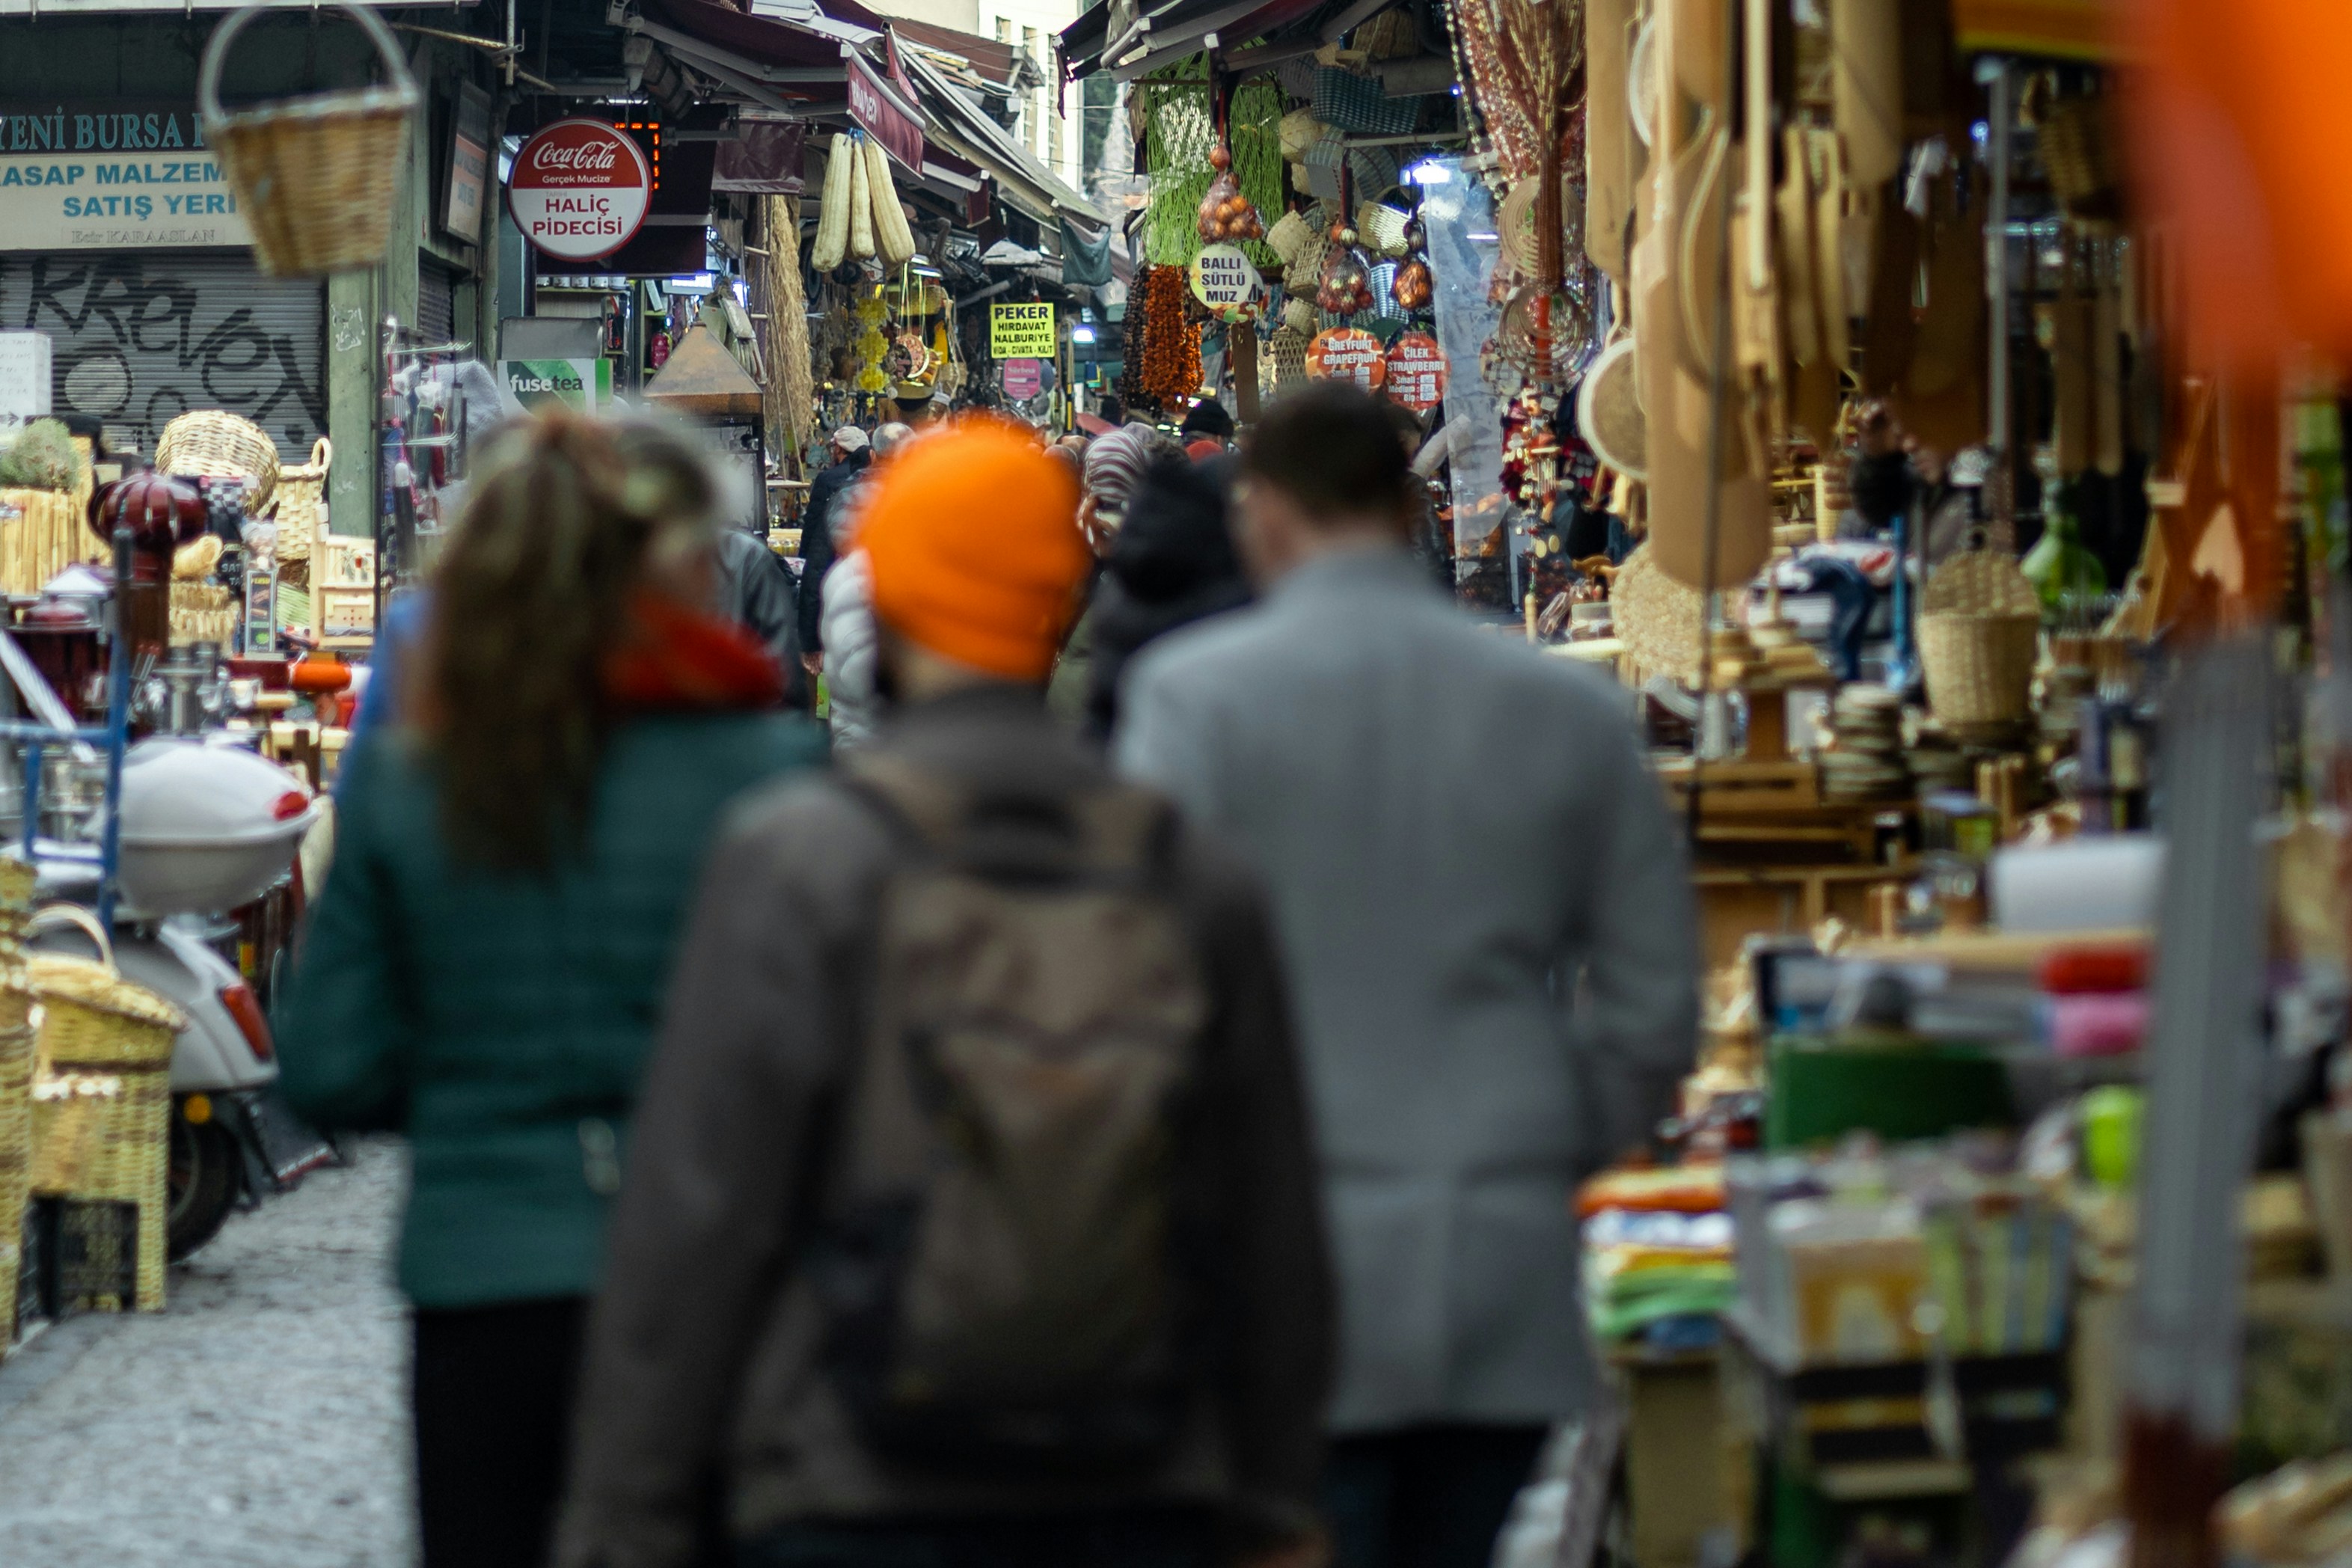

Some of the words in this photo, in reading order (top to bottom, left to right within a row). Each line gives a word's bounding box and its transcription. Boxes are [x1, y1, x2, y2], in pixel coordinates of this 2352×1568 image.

[74, 113, 184, 149] BURSA
[533, 141, 620, 169] Coca-Cola
[0, 165, 85, 186] ASAP
[97, 163, 227, 184] MALZEM
[542, 175, 575, 186] Gerçek
[578, 175, 610, 183] Mucize
[63, 195, 153, 221] SATIŞ
[545, 195, 610, 215] HALİÇ
[533, 216, 622, 236] PİDECİSİ
[106, 229, 215, 243] KARAASLAN
[1201, 257, 1241, 269] BALLI
[1201, 272, 1246, 286] SÜTLÜ
[1206, 291, 1237, 302] MUZ
[994, 307, 1048, 319] PEKER
[997, 322, 1047, 331] HIRDAVAT
[1323, 352, 1378, 364] GRAPEFRUIT
[1387, 361, 1445, 372] STRAWBERRY
[1396, 376, 1415, 384] Small
